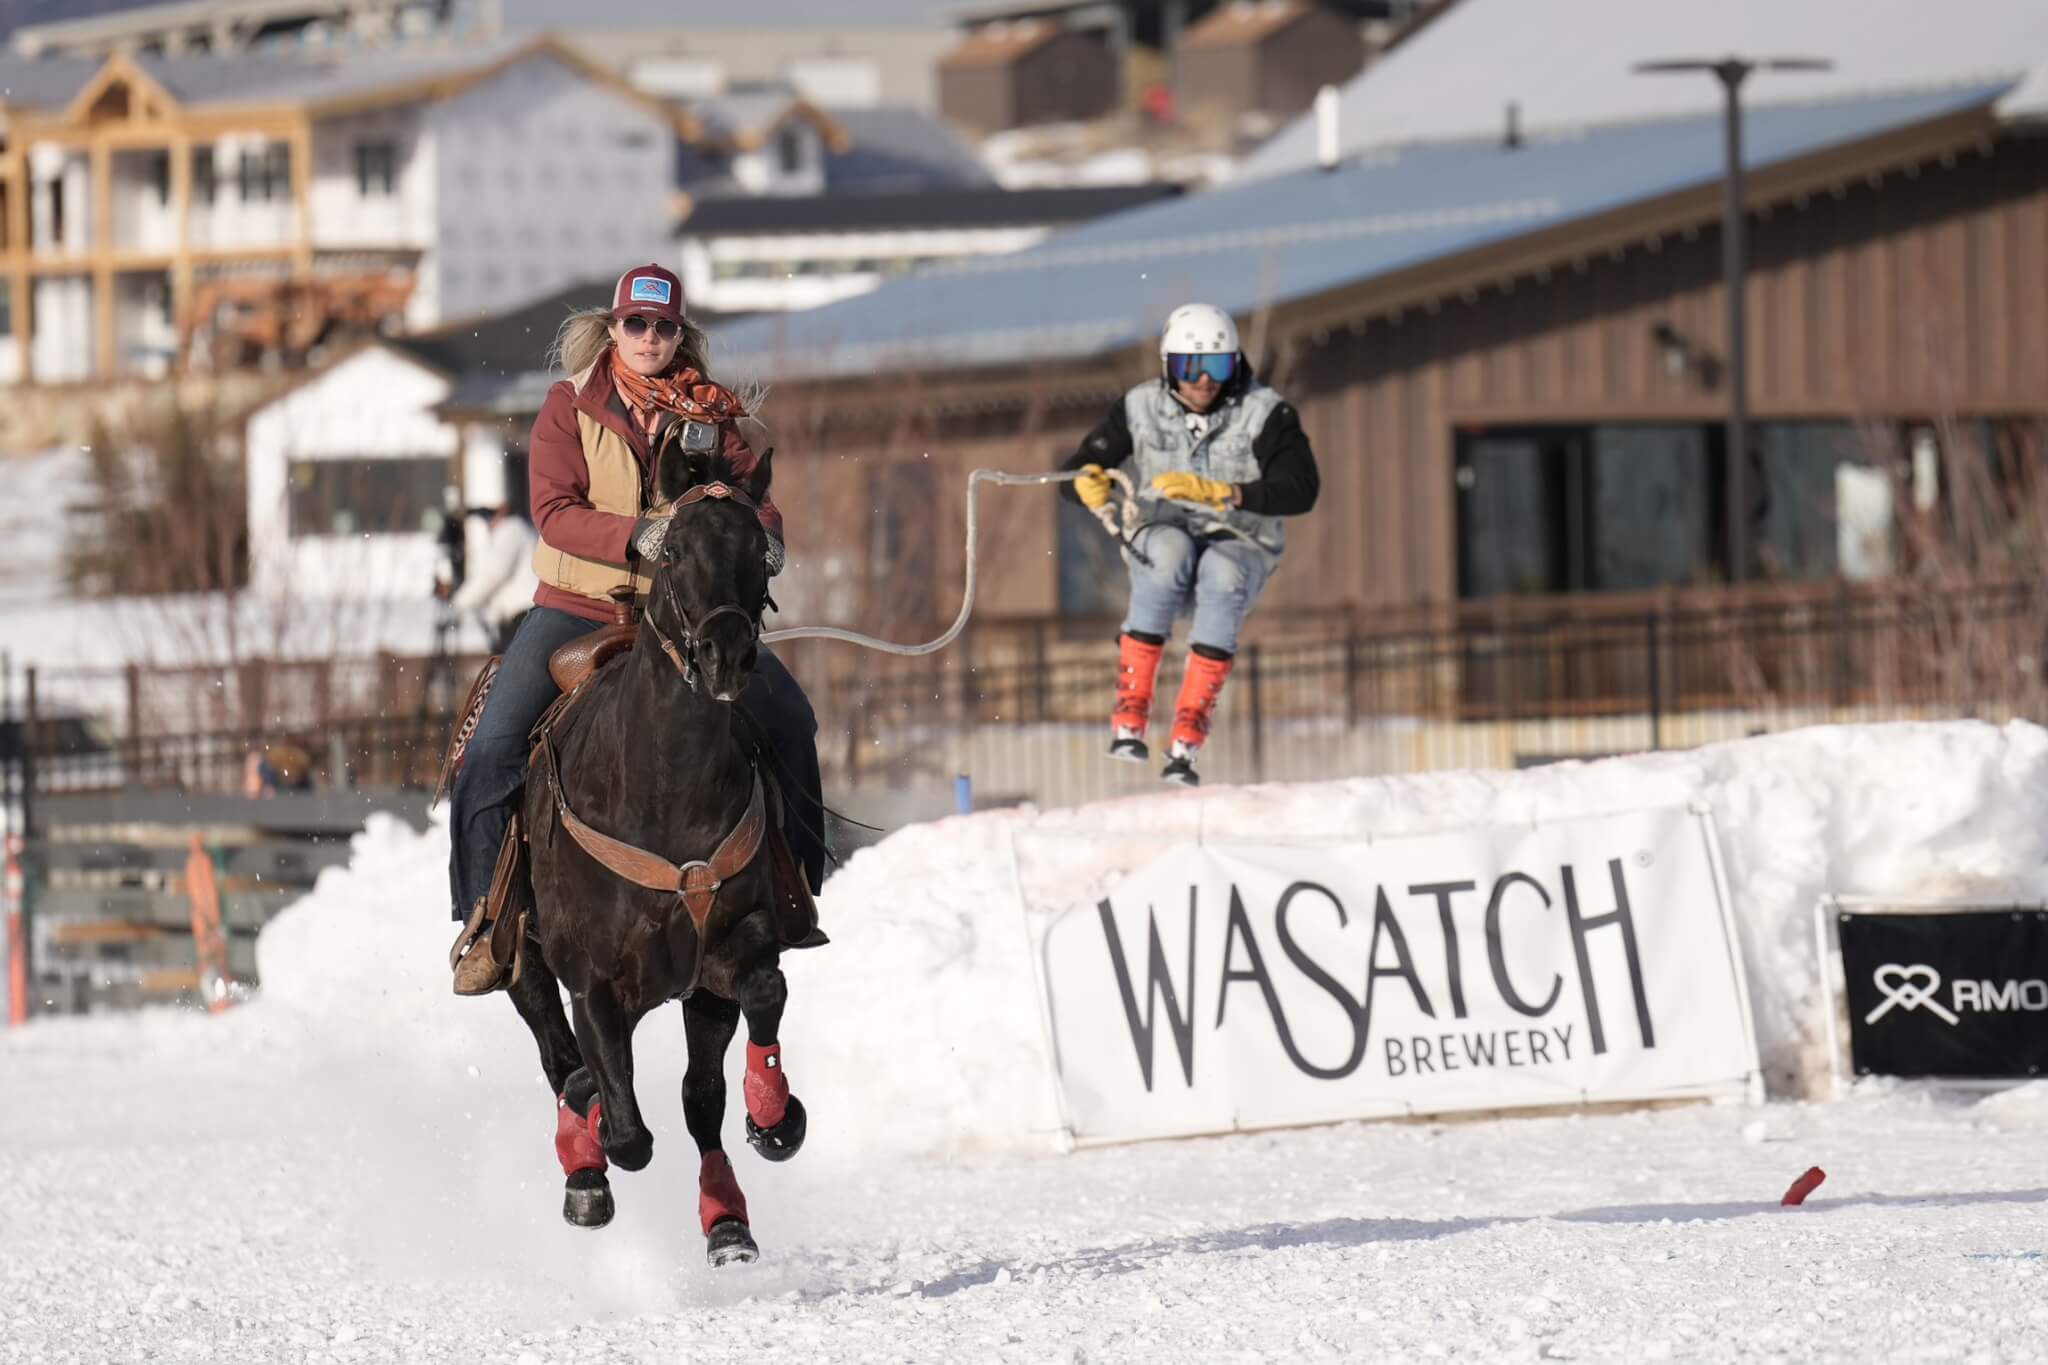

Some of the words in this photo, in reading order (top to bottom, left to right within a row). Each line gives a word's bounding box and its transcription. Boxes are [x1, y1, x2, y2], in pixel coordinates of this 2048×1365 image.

[1098, 858, 1656, 1092] WASATCH
[1952, 979, 2048, 1012] RMO
[1385, 1025, 1573, 1077] BREWERY
